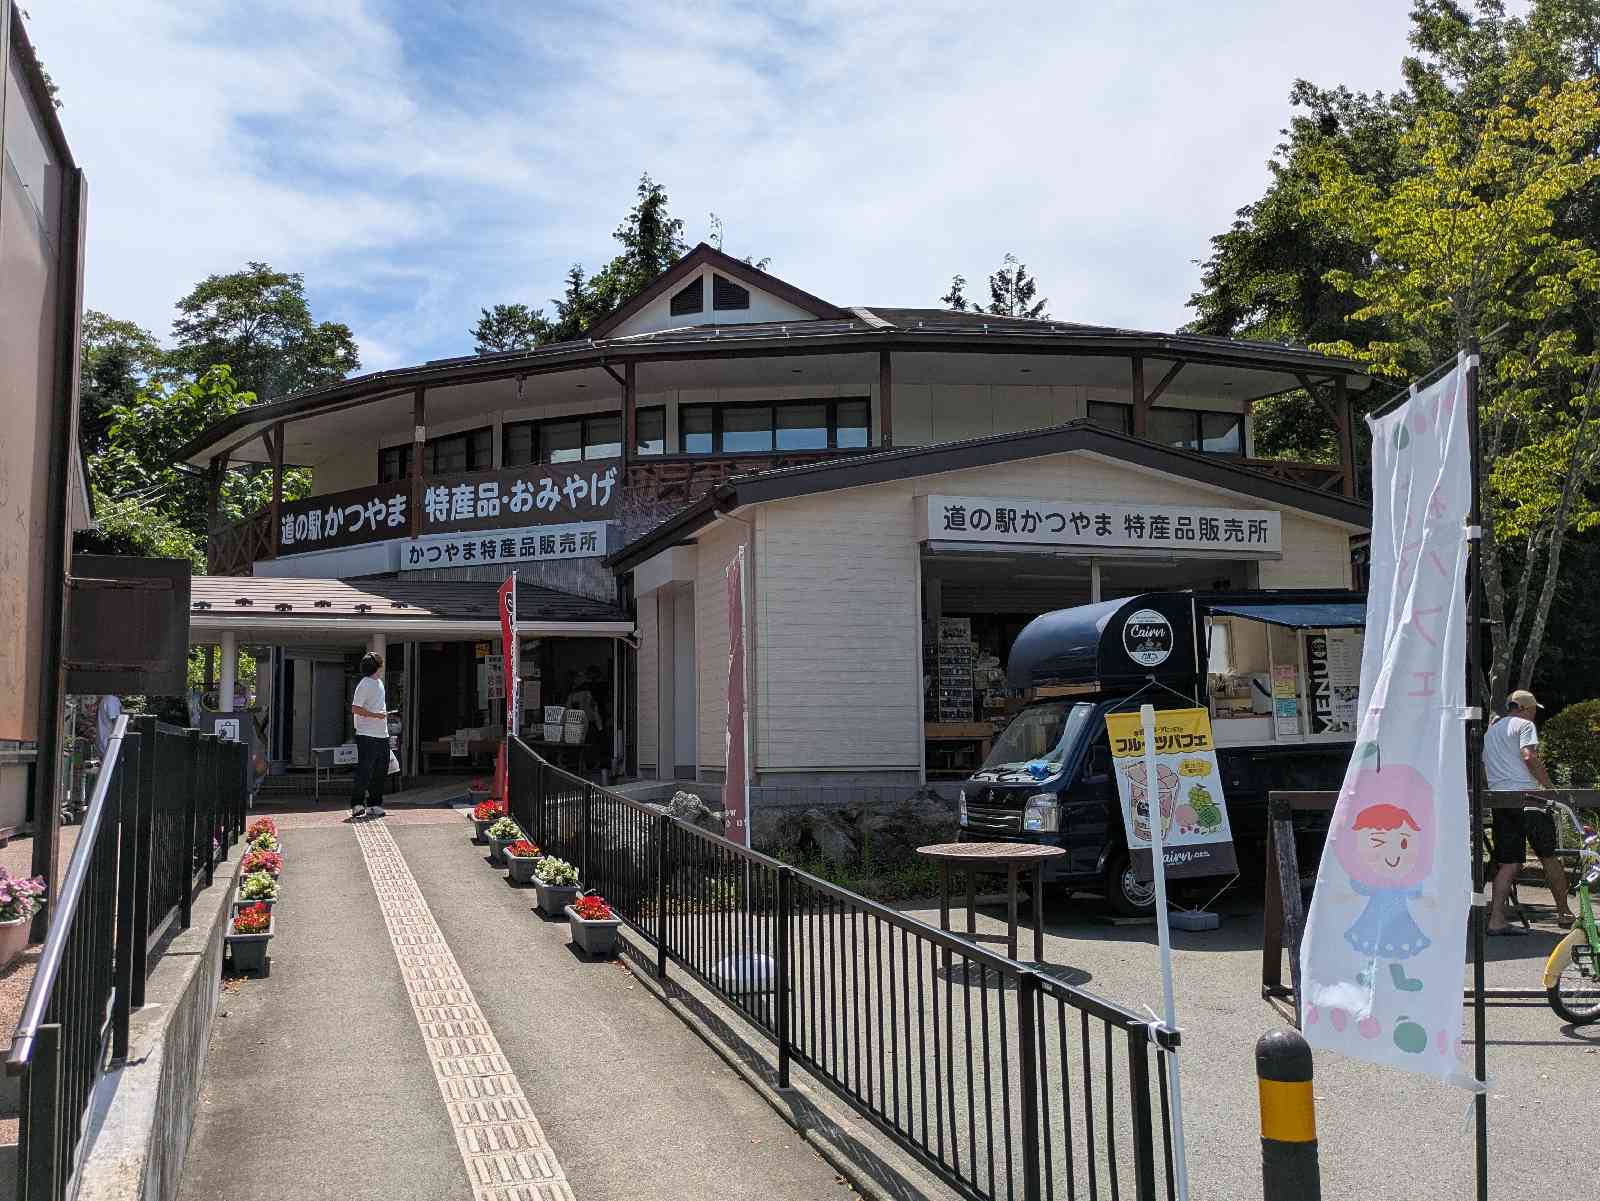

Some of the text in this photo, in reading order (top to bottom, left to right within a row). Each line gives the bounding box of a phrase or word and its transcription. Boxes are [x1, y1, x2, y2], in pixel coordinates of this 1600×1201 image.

[281, 466, 619, 546] 道の駅かつやま 特産品・おみやげ
[943, 504, 1269, 545] 道の駅かつやま 特産品販売所
[408, 529, 598, 565] かつやま特産品販売所
[1312, 659, 1344, 736] MENU
[1115, 733, 1208, 753] フルツパフェ
[1160, 849, 1194, 865] airn
